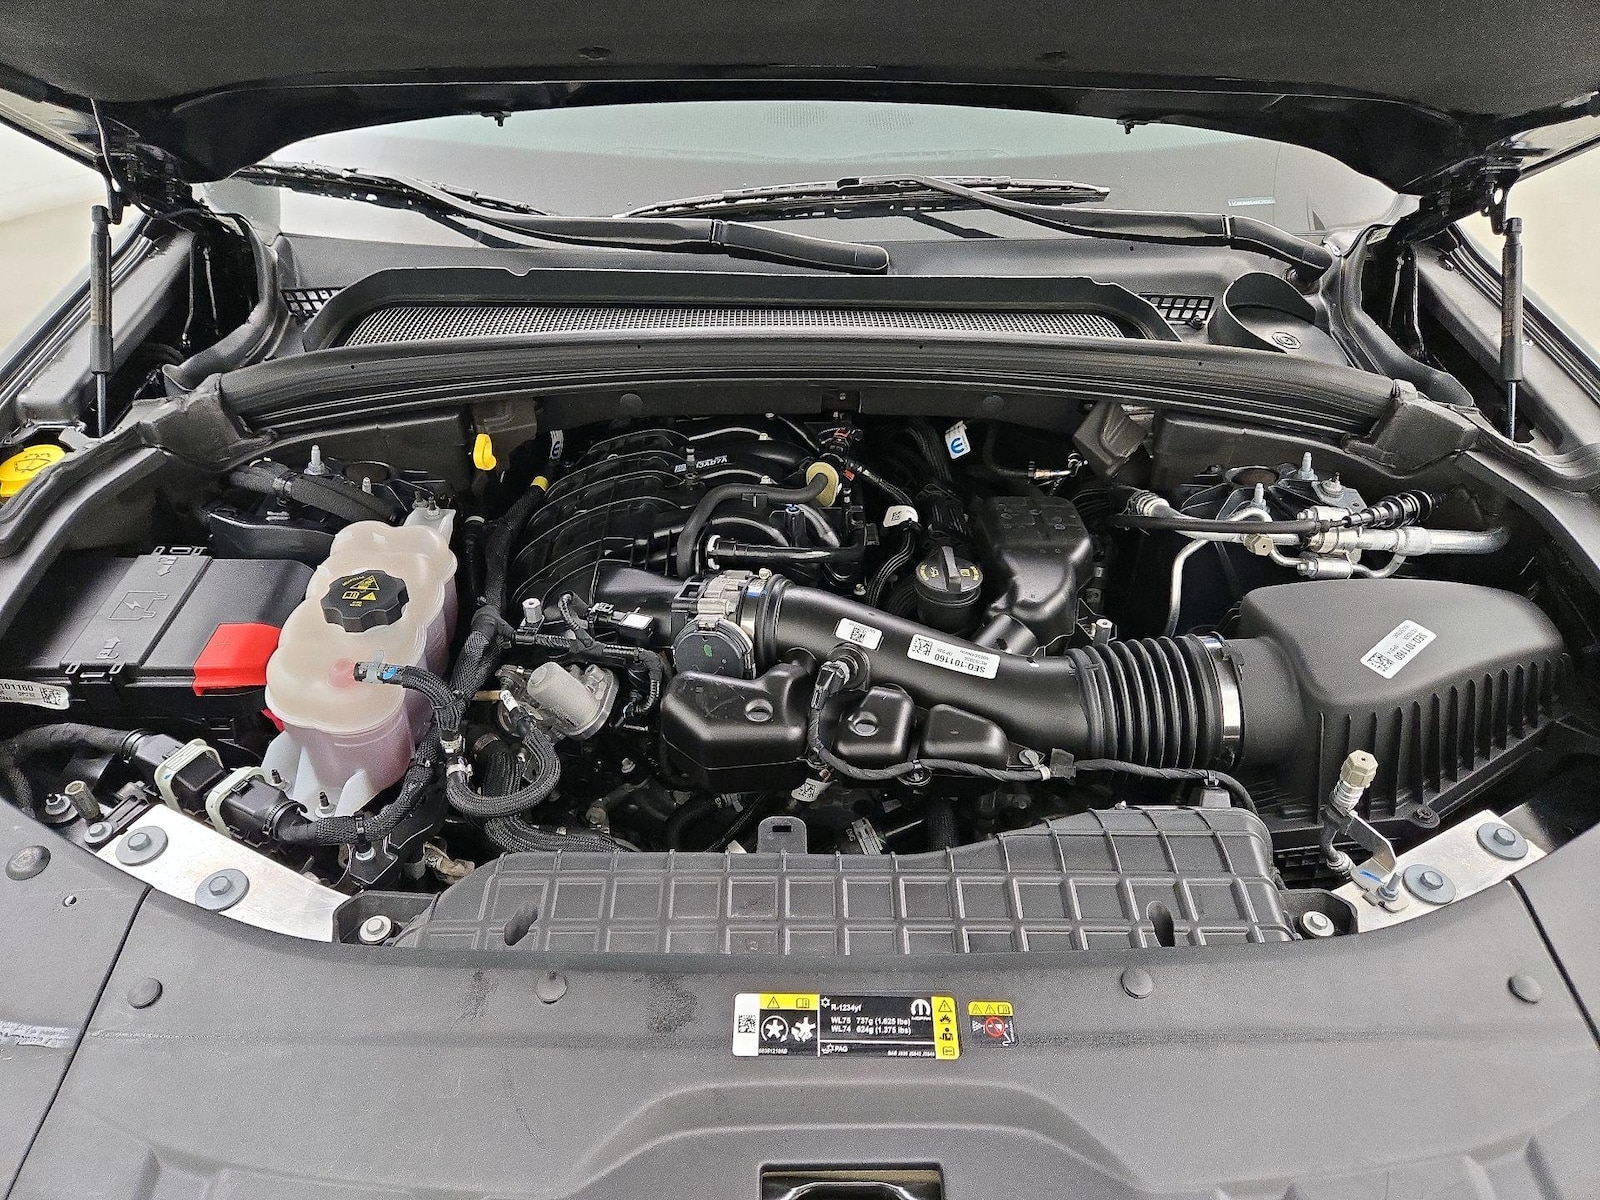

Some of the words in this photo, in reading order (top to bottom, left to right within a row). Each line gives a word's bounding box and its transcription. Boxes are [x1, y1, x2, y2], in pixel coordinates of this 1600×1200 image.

[934, 653, 986, 673] SEQ:101160
[830, 1003, 862, 1013] R-1234yf
[830, 1016, 852, 1024] WL75
[856, 1017, 874, 1026] 737g
[875, 1017, 896, 1026] (1.625
[897, 1017, 911, 1027] lbs)
[830, 1025, 852, 1033] WL74
[856, 1026, 874, 1035] 624g
[875, 1026, 896, 1035] (1.375
[898, 1026, 912, 1035] lbs)
[834, 1045, 849, 1053] PAG
